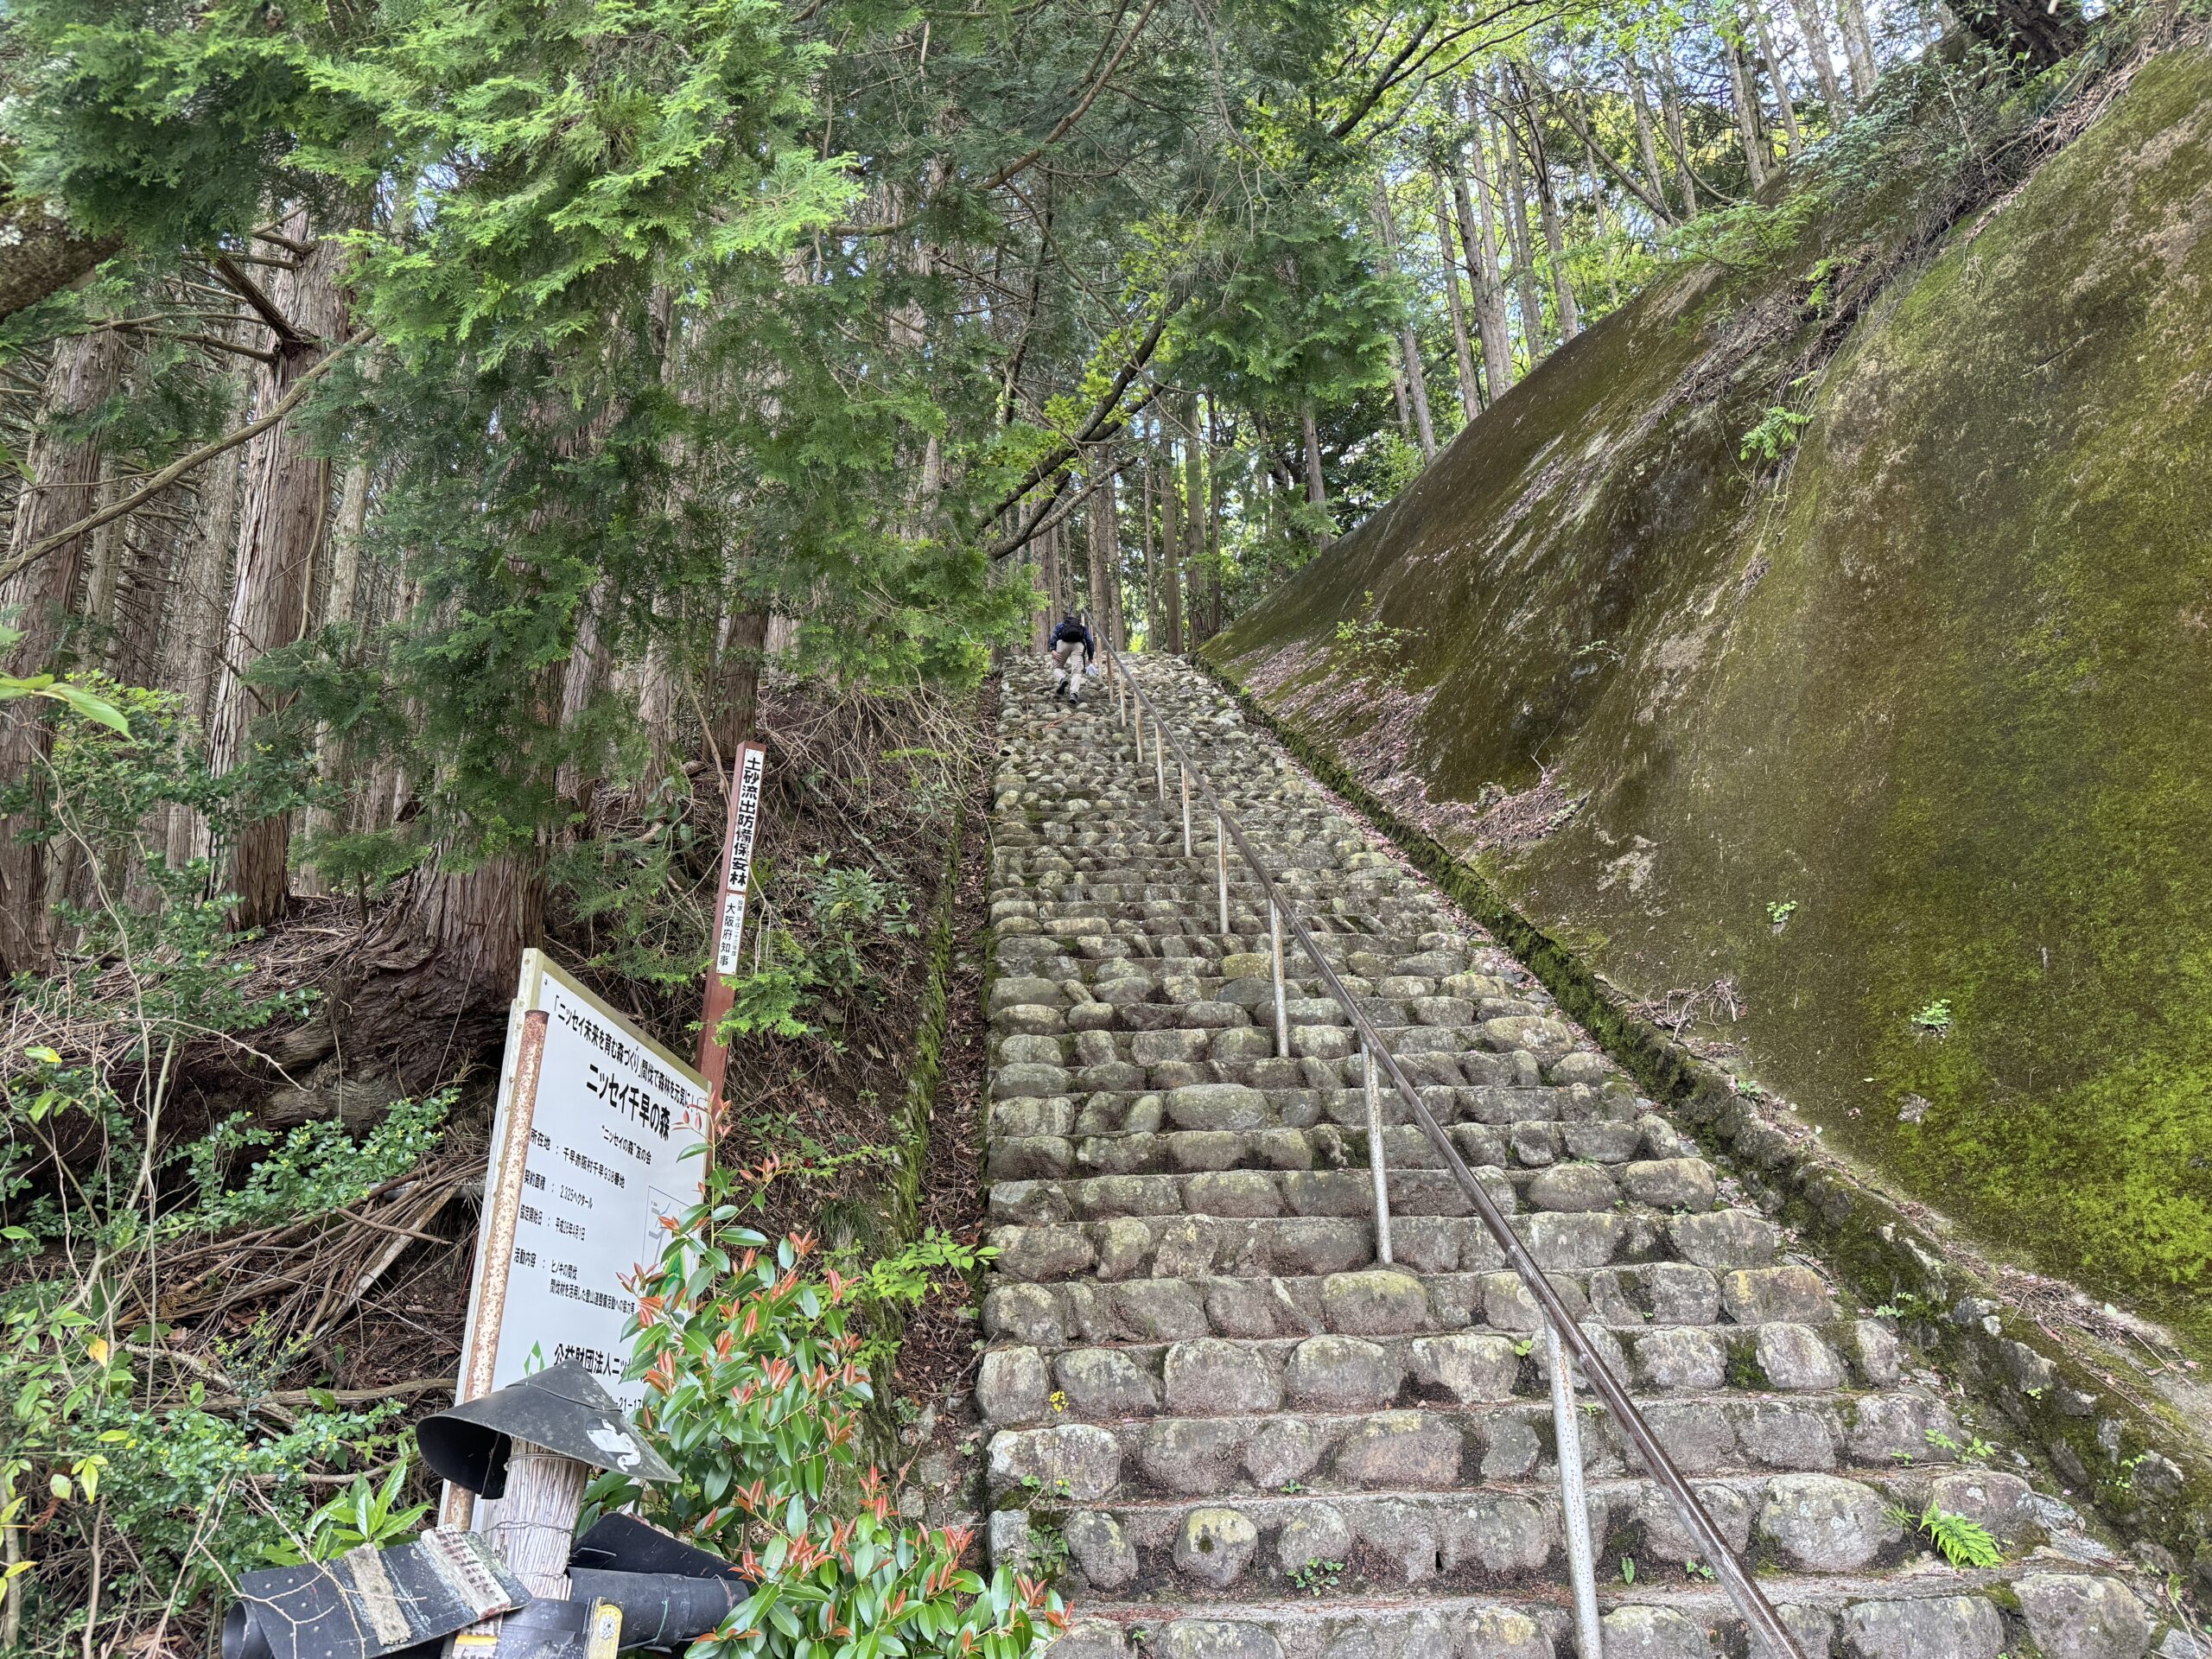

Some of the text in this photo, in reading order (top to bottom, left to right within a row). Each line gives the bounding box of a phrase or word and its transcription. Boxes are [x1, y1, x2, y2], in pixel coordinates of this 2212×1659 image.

[729, 757, 761, 887] 土砂流出防備保安林
[719, 902, 736, 967] 大阪府知事
[586, 1064, 671, 1141] ニッセイ千早の森
[524, 1169, 546, 1192] 契約面積
[529, 1128, 551, 1151] 所在地
[563, 1147, 626, 1189] 千早赤阪村千早938番地
[513, 1247, 537, 1268] 活動内容
[551, 1259, 578, 1281] ヒノキの間伐
